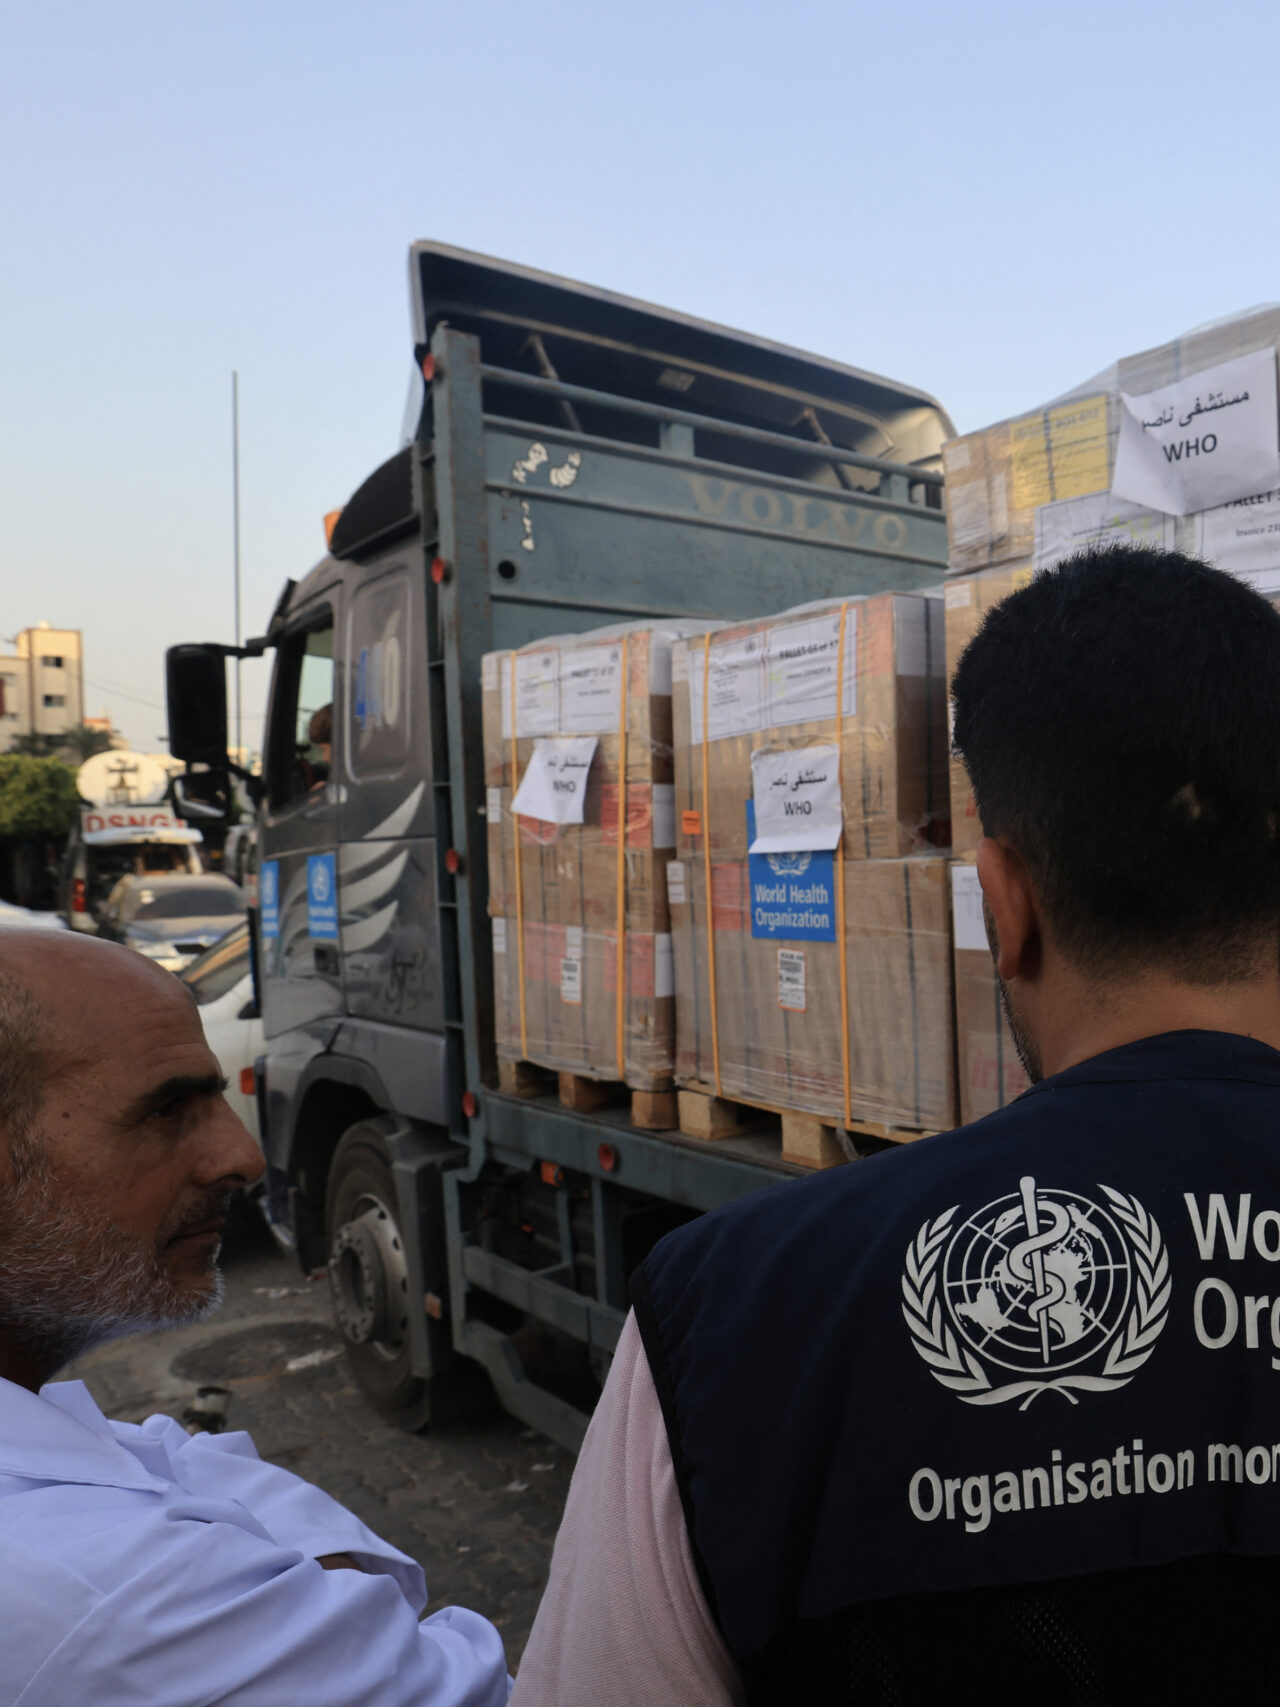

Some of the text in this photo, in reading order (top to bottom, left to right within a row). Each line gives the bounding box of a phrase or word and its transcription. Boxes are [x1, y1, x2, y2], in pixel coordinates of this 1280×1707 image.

[1163, 434, 1218, 463] WHO
[680, 471, 909, 549] VOLVO
[784, 800, 812, 816] WHO
[755, 883, 829, 905] World Health
[755, 907, 829, 932] Organization
[908, 1439, 1195, 1534] Organisation
